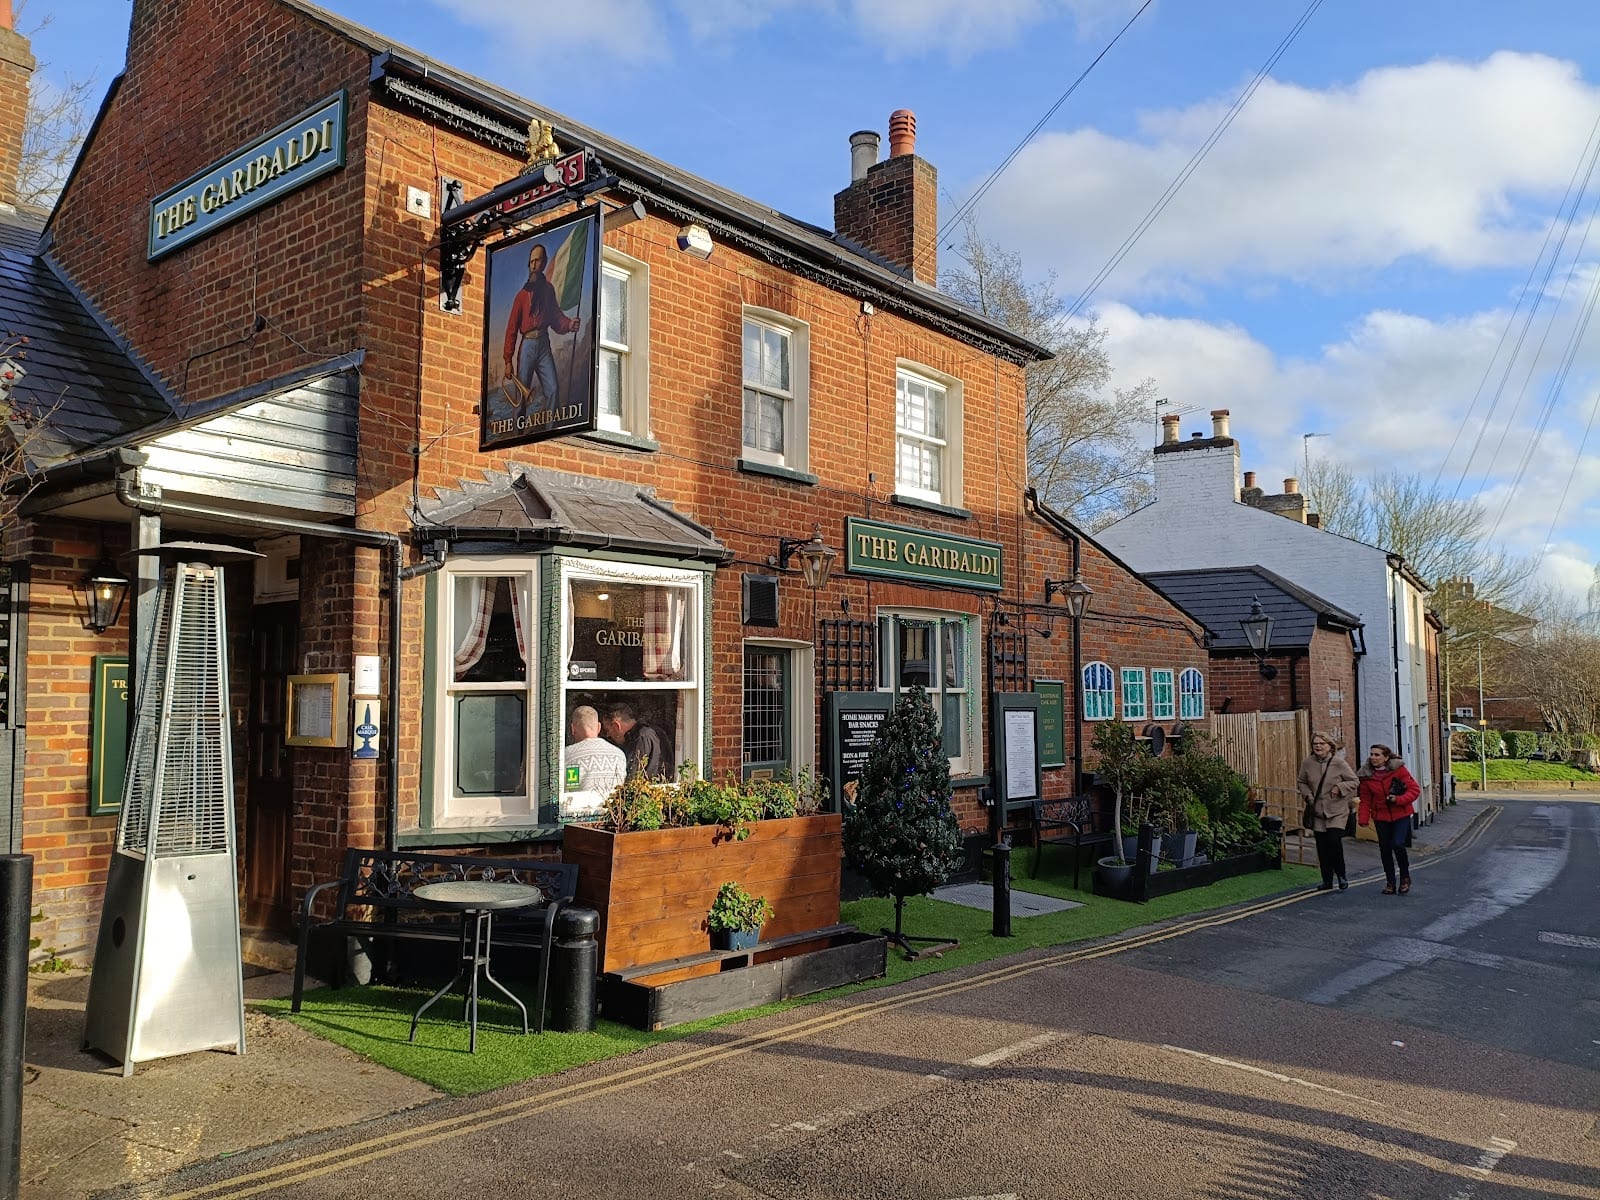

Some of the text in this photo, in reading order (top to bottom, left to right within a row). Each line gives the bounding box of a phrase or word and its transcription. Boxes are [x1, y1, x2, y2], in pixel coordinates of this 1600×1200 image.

[156, 118, 333, 238] THE GARIBALDI
[491, 403, 583, 434] THE GARIBALDI
[857, 533, 998, 576] THE GARIBALDI
[596, 629, 646, 646] GARIBA
[625, 616, 644, 628] THE
